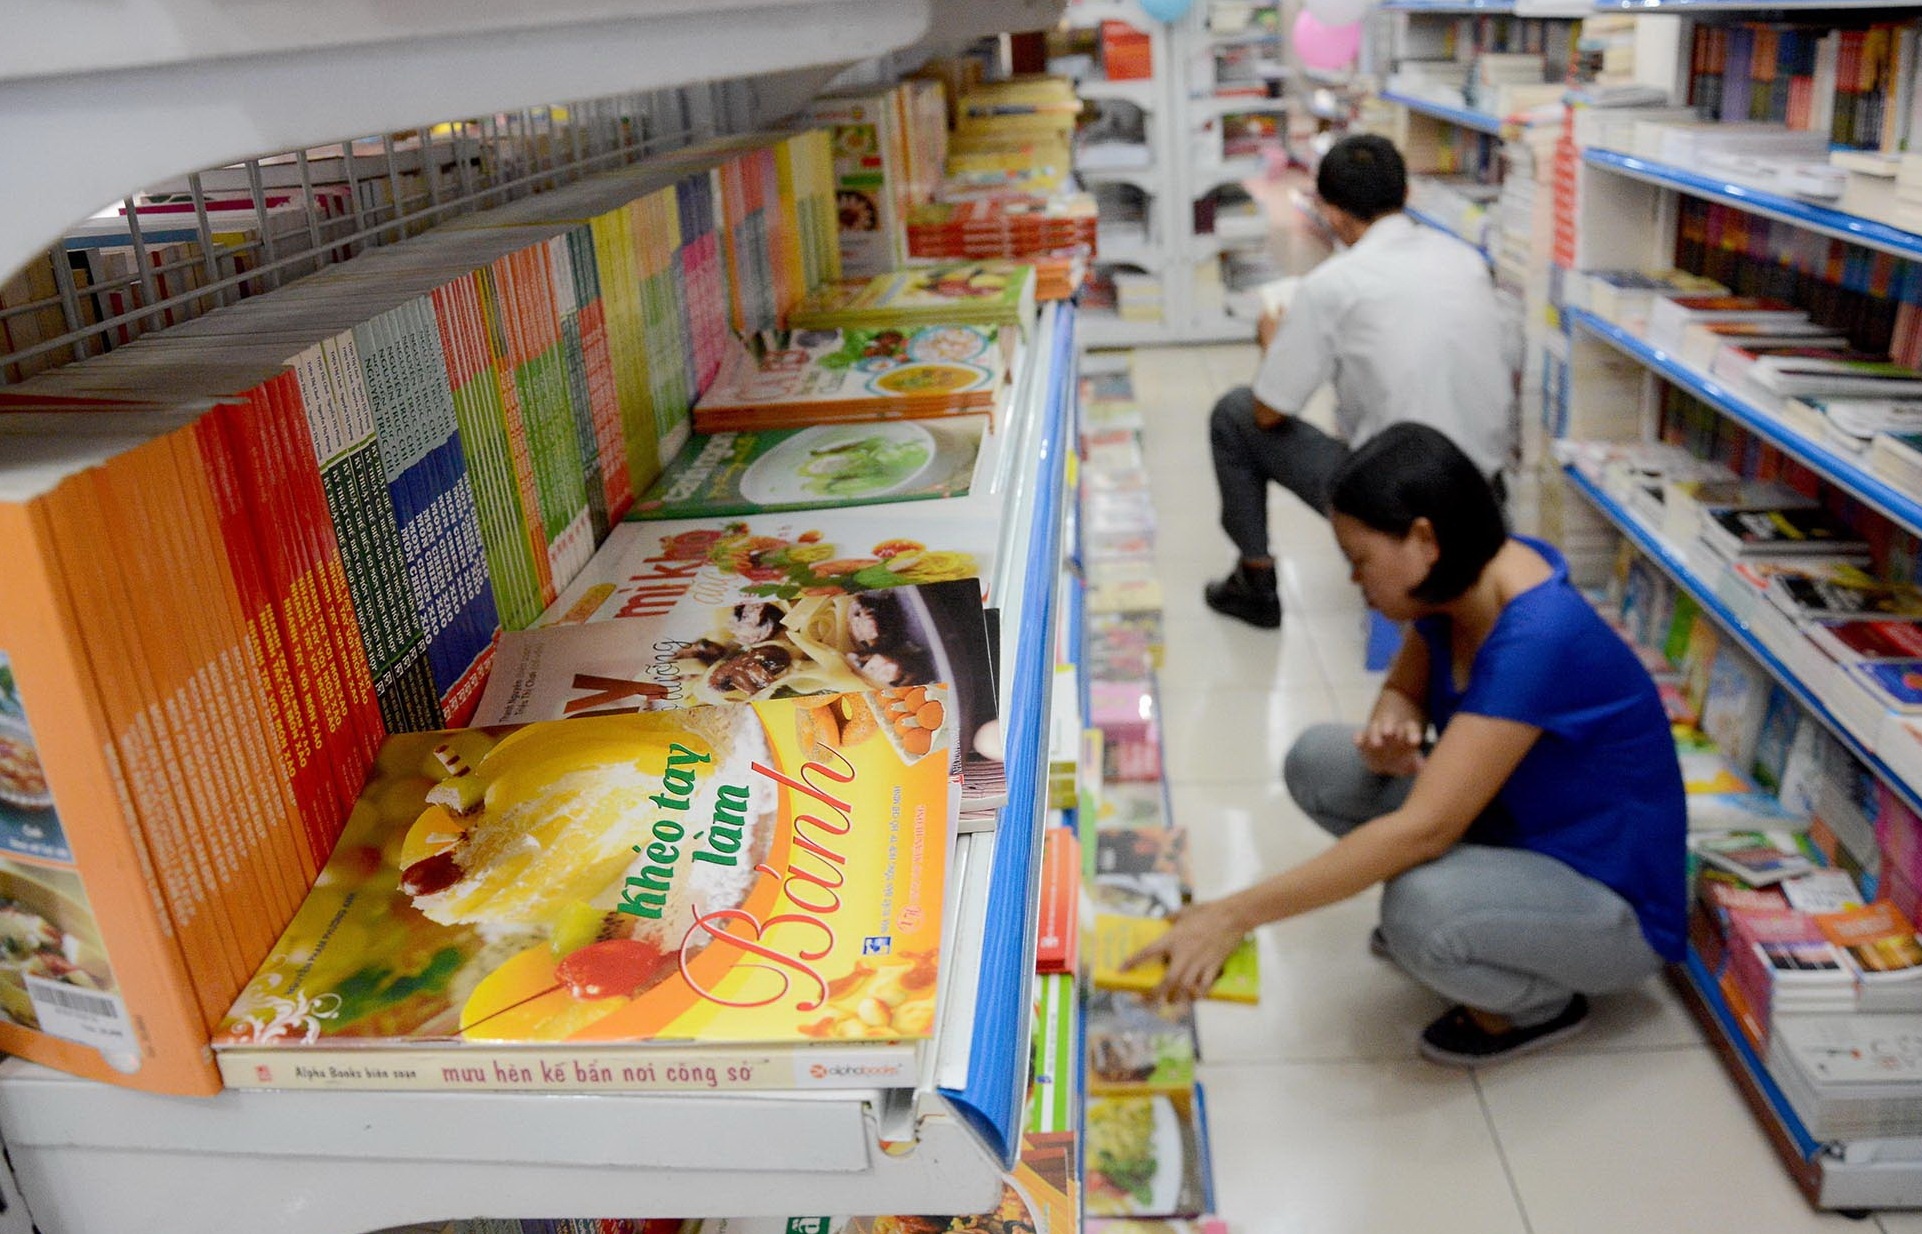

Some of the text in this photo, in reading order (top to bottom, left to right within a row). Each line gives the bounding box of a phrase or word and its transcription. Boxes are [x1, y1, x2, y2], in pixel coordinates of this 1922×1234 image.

[398, 438, 408, 460] CHI
[406, 435, 415, 456] CHI
[384, 450, 394, 473] CHI
[385, 540, 391, 552] 60
[392, 533, 398, 545] 60
[366, 554, 373, 566] 60
[376, 547, 383, 559] 60
[355, 562, 362, 574] 60
[306, 570, 320, 612] NHANH
[317, 614, 326, 635] TAY
[328, 560, 342, 602] NHANH
[340, 605, 348, 625] TAY
[290, 582, 305, 626] NHANH
[303, 628, 313, 649] TAY
[284, 598, 297, 642] NHANH
[294, 644, 303, 665] TAY
[248, 620, 264, 670] NHANH
[260, 668, 271, 697] TAY
[617, 743, 711, 919] khéo tay
[692, 784, 750, 867] làm
[678, 741, 856, 1012] Bánh
[295, 1067, 325, 1082] Alpha
[330, 1067, 362, 1079] Books
[442, 1065, 486, 1083] mưu
[493, 1059, 532, 1083] hèn
[666, 1061, 719, 1088] công
